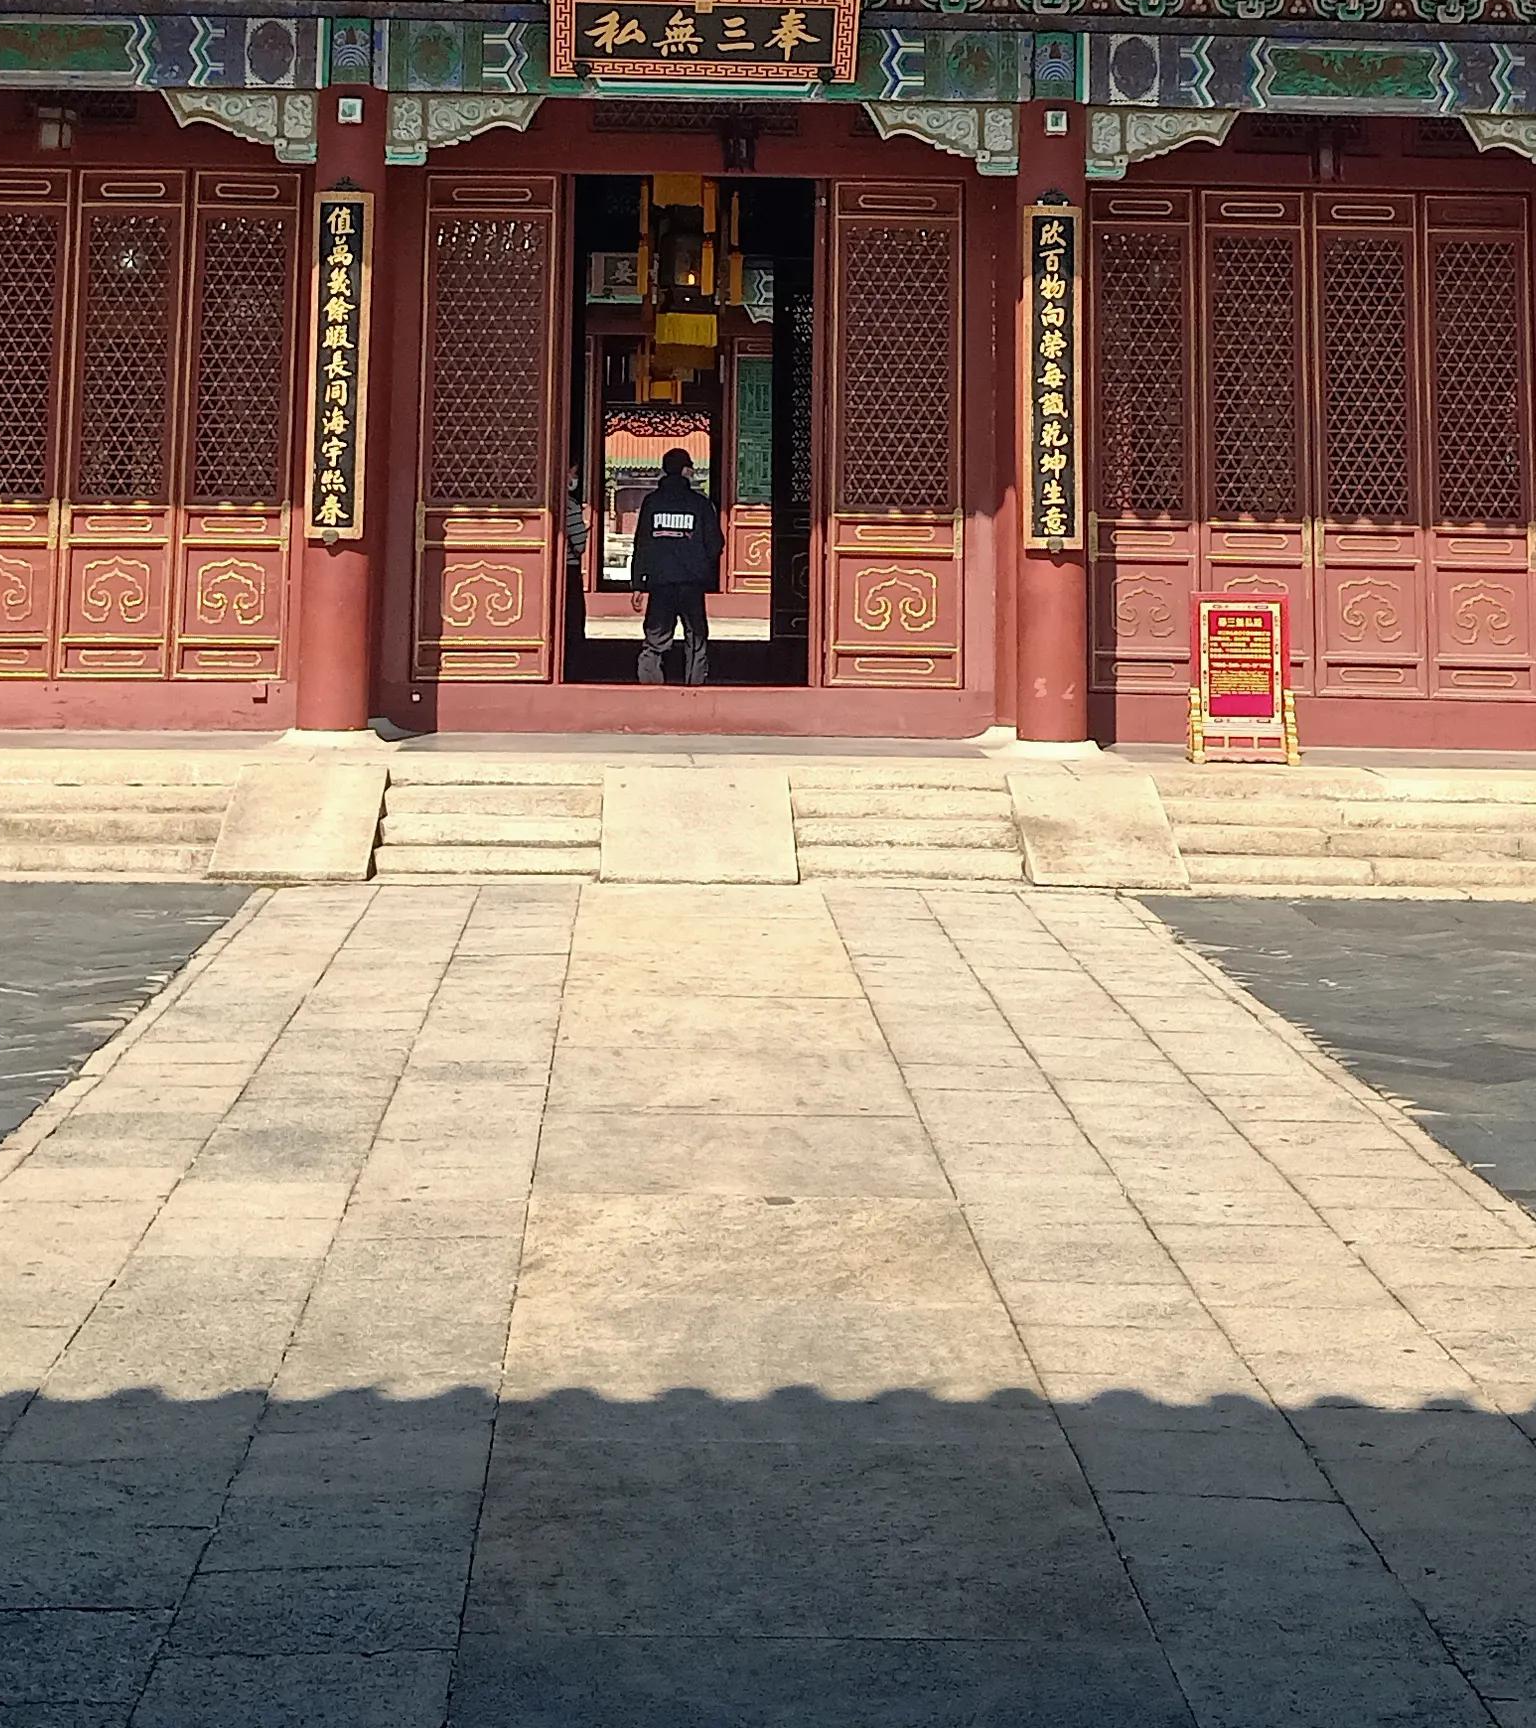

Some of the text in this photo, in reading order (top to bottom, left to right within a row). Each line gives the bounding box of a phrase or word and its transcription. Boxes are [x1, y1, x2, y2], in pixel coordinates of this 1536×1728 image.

[584, 8, 821, 62] 奉三無私
[654, 513, 694, 529] PUMA
